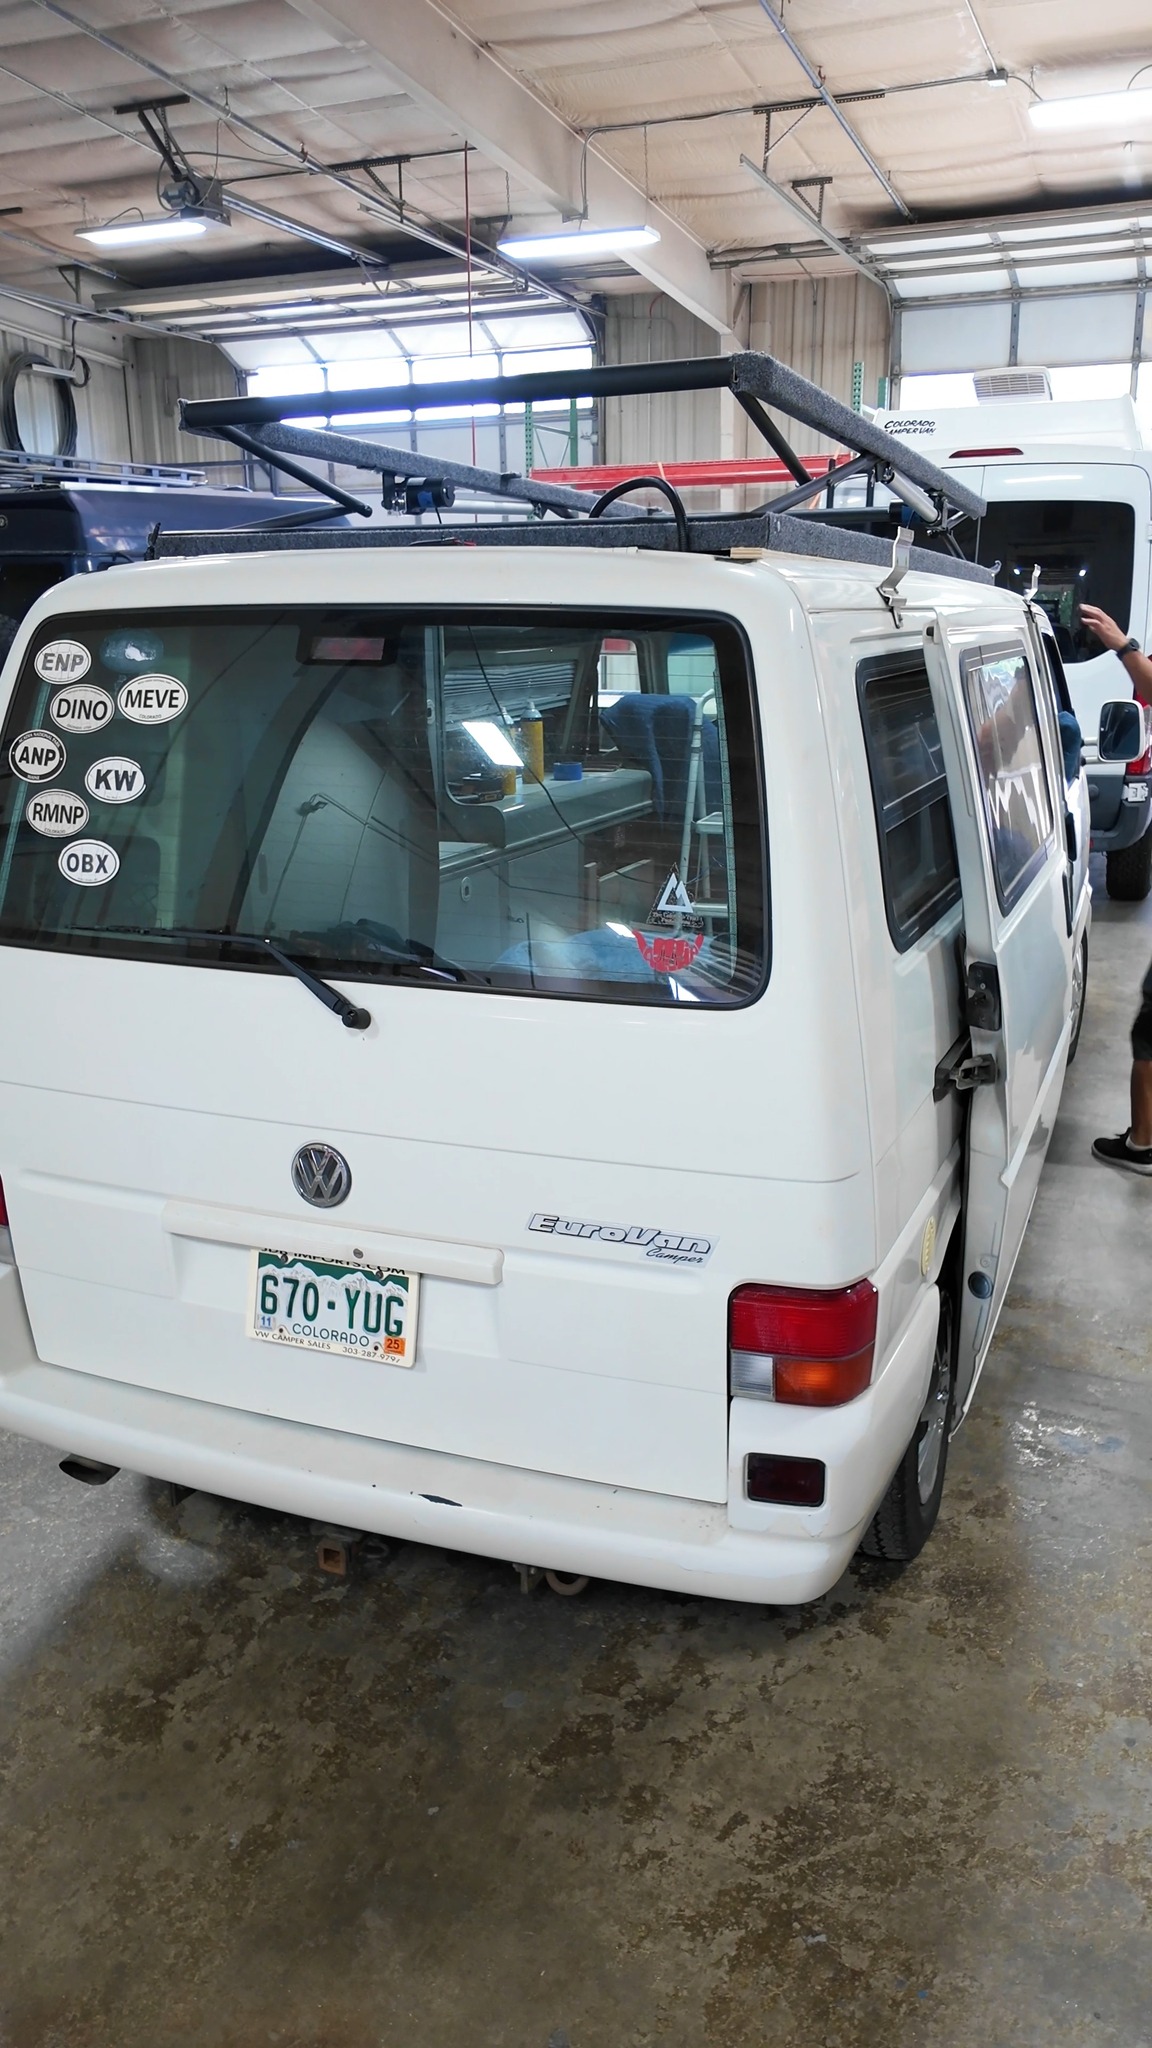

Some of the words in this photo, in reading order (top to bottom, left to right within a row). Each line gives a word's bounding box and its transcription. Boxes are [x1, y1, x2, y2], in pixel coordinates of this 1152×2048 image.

[884, 420, 936, 429] COLORADO
[41, 652, 84, 672] ENP
[124, 689, 180, 708] MEVE
[56, 698, 108, 721] DINO
[18, 746, 57, 767] ANP
[95, 769, 137, 791] KW
[32, 802, 84, 825] RMNP
[66, 852, 109, 874] OBX
[528, 1213, 712, 1254] EuroVan
[645, 1247, 704, 1265] Camper
[260, 1316, 272, 1327] 11
[254, 1330, 270, 1338] VW
[271, 1333, 305, 1345] CAMPER
[307, 1339, 331, 1350] SALES
[292, 1323, 370, 1347] COLORADO
[386, 1338, 400, 1350] 25
